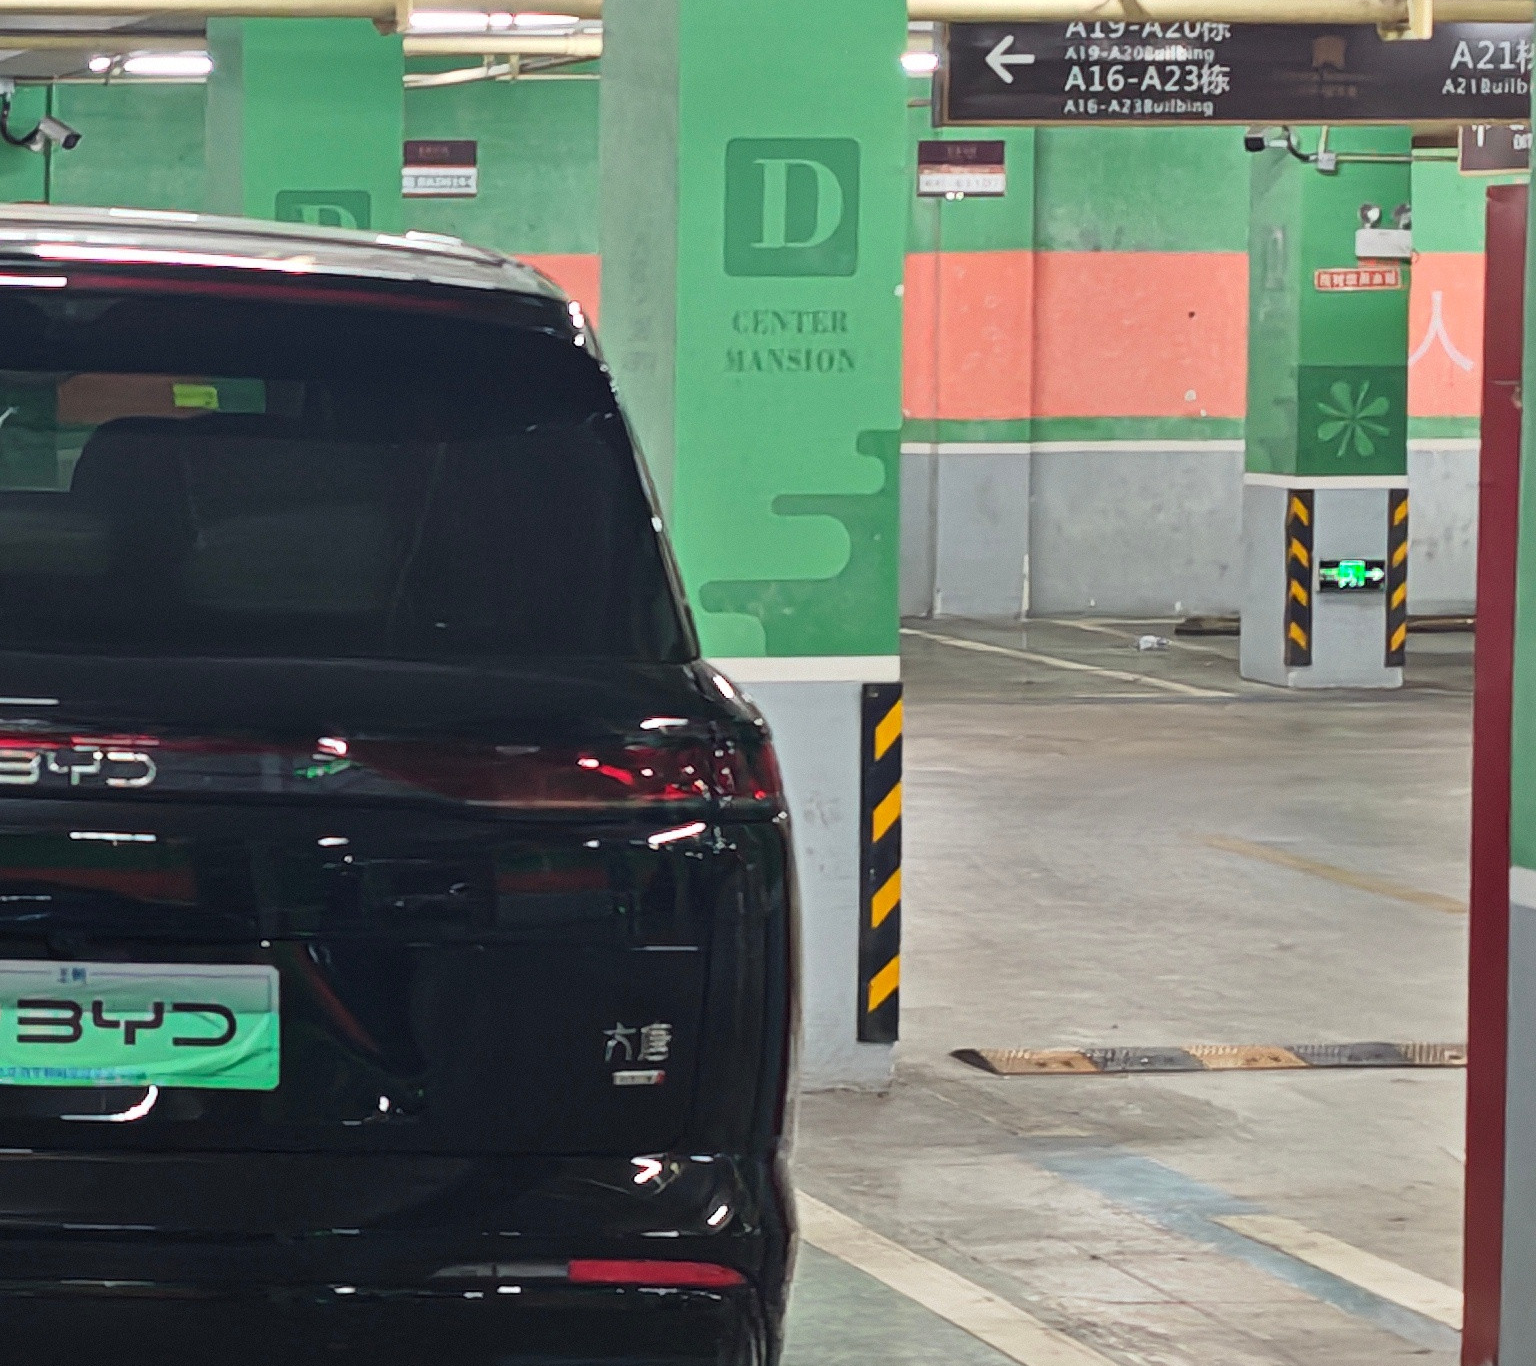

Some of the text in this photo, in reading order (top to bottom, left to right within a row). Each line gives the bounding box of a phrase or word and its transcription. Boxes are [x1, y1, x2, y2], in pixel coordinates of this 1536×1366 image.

[1064, 63, 1231, 96] A16-A23栋
[1441, 76, 1531, 96] A21Builb
[750, 158, 844, 249] D
[731, 309, 848, 335] CENTER
[724, 348, 856, 374] MANSION
[16, 998, 237, 1047] BYD
